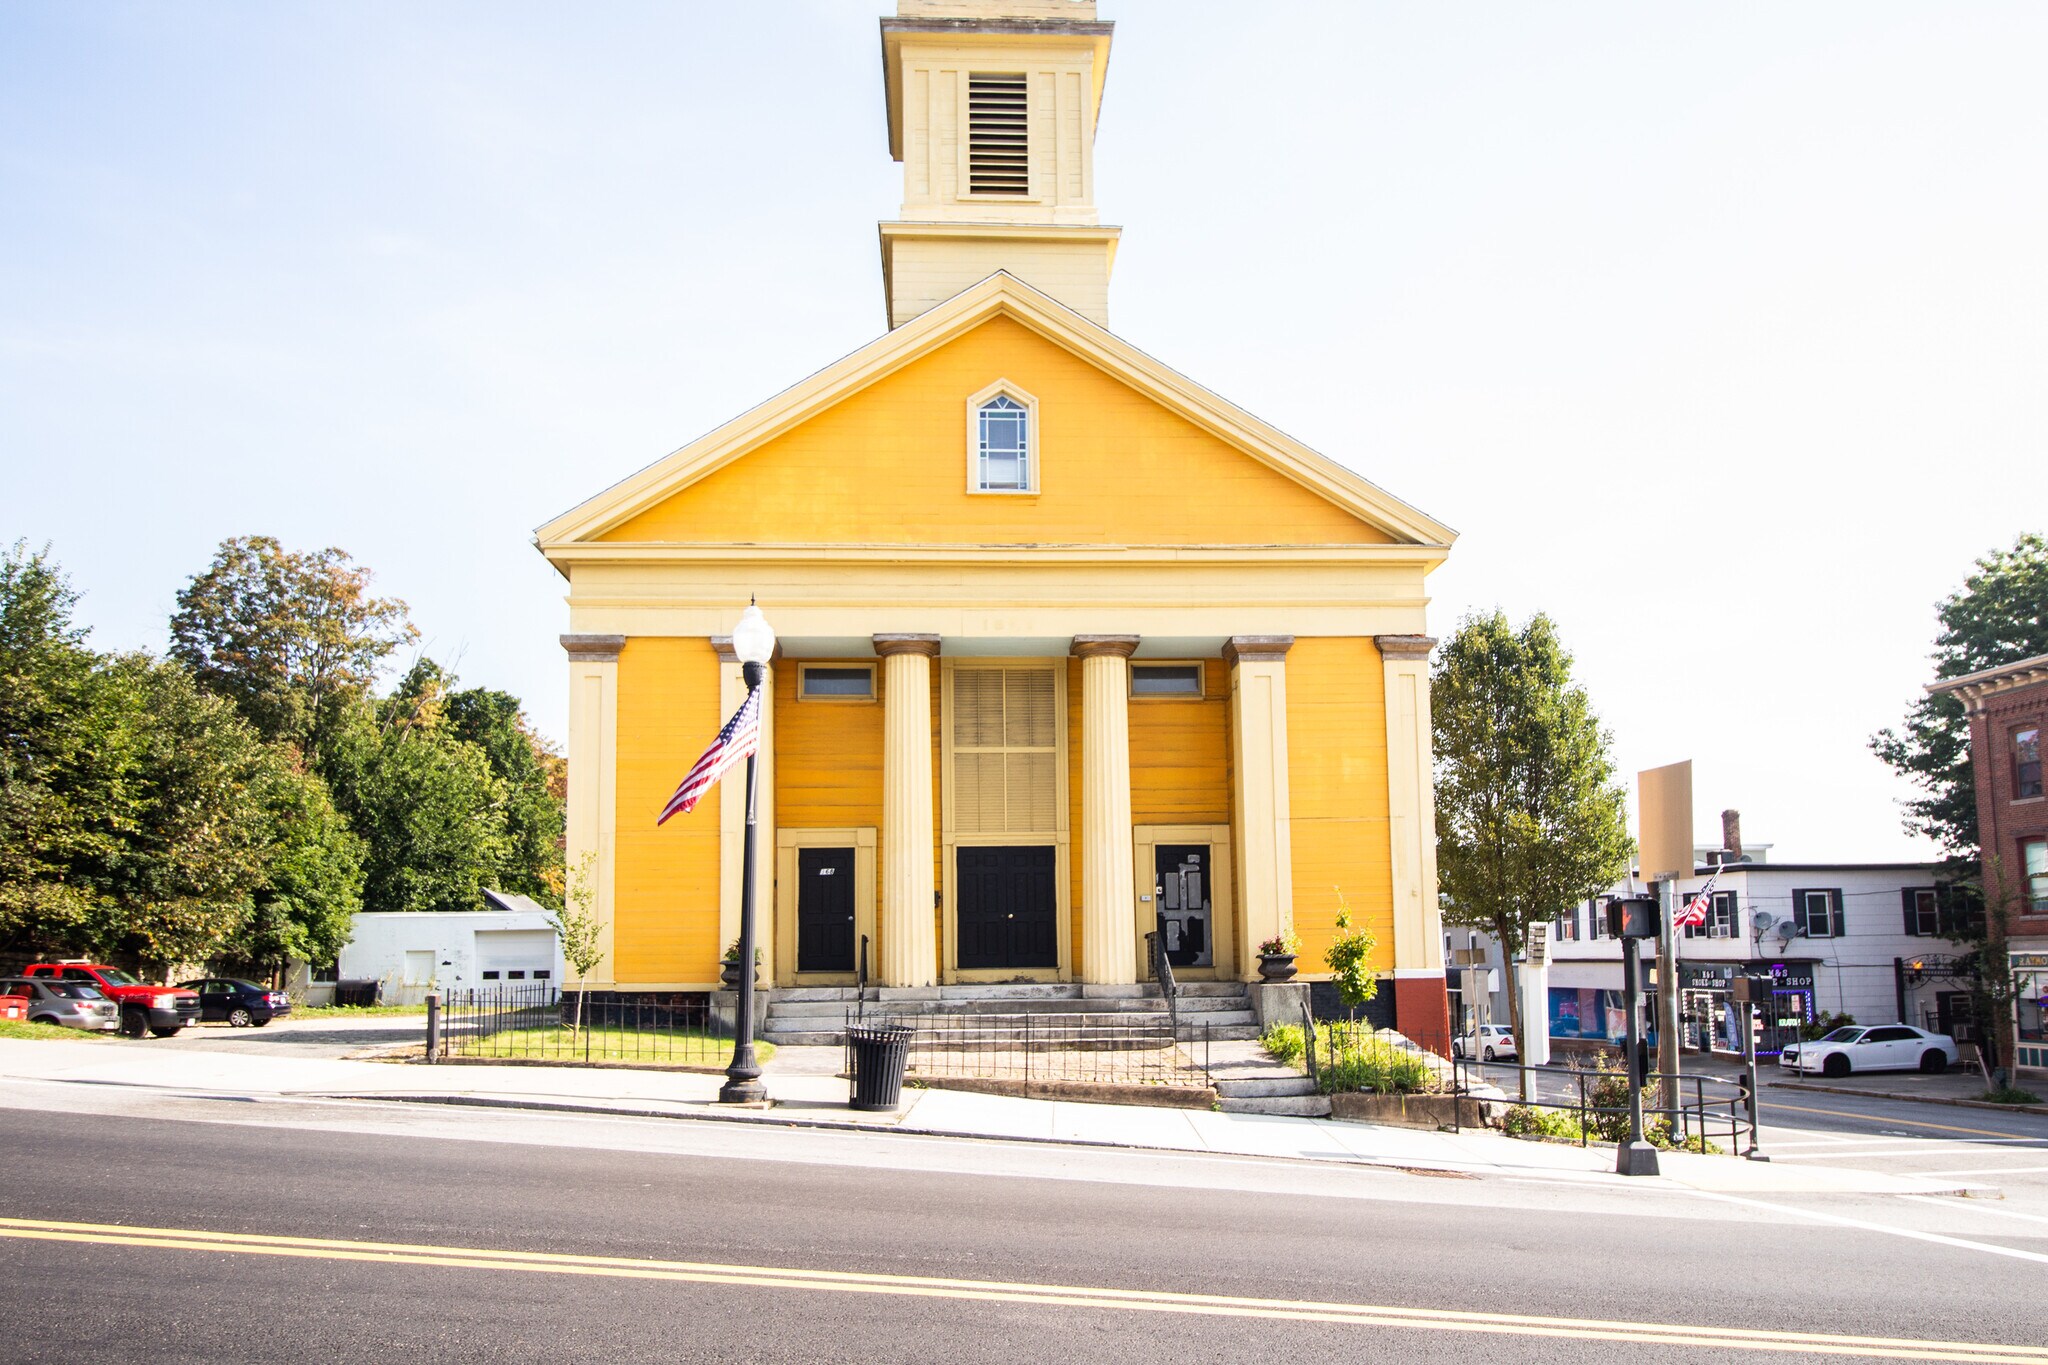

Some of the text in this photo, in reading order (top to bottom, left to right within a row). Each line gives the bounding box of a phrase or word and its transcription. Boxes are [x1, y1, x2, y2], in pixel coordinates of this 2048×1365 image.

[1768, 969, 1788, 978] M&S
[1692, 978, 1726, 987] SMOKE SHOP
[1786, 977, 1812, 986] SHOP
